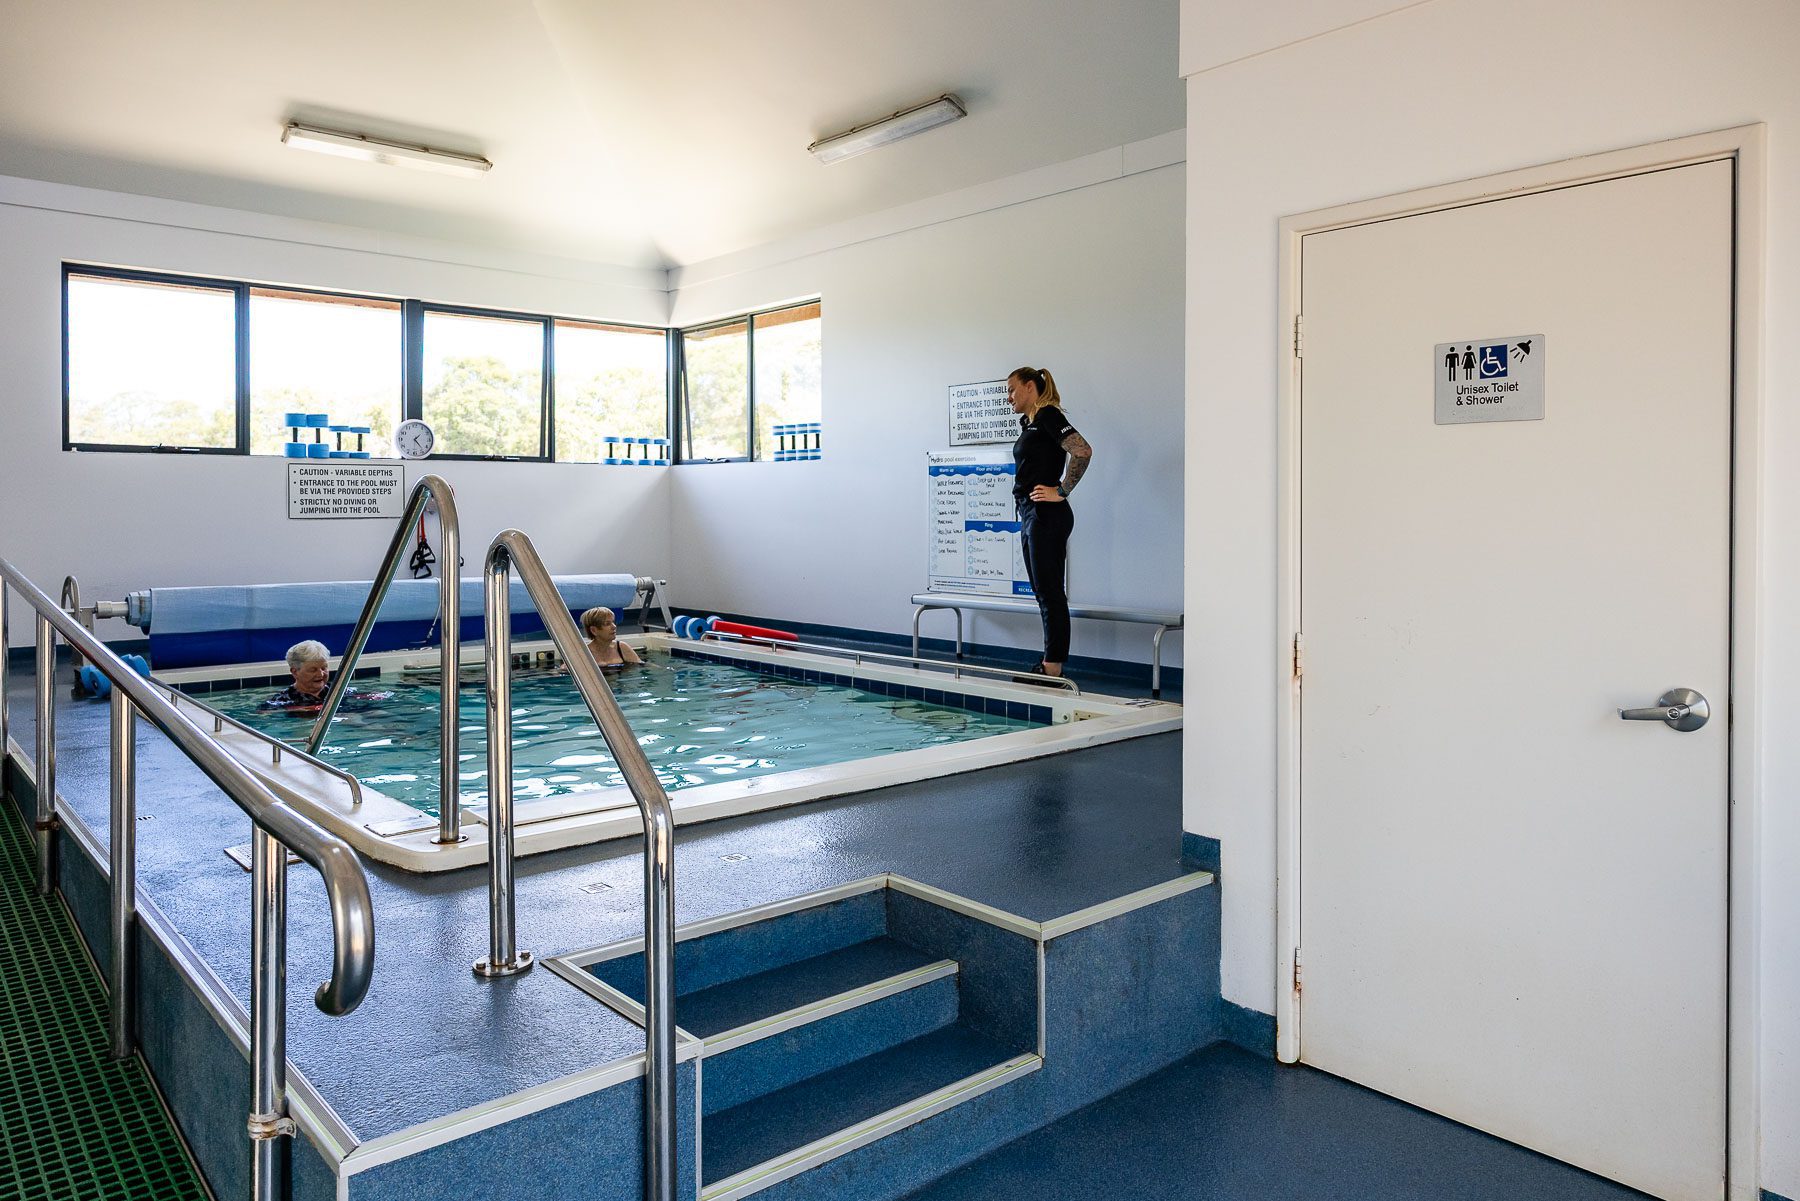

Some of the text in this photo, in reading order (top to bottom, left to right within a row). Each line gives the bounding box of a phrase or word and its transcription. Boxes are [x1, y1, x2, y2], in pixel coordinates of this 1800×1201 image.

[956, 389, 978, 398] CAUTION
[982, 386, 1008, 396] VARIABLE
[1456, 382, 1519, 395] Unisex Toilet
[956, 400, 982, 410] ENTRANCE
[1456, 395, 1504, 406] & Shower
[974, 410, 983, 418] THE
[985, 407, 1011, 417] PROVIDED
[957, 421, 979, 430] STRICTLY
[990, 420, 1007, 428] DIVING
[957, 431, 979, 440] JUMPING
[980, 431, 992, 439] INTO
[1005, 429, 1019, 437] POOL
